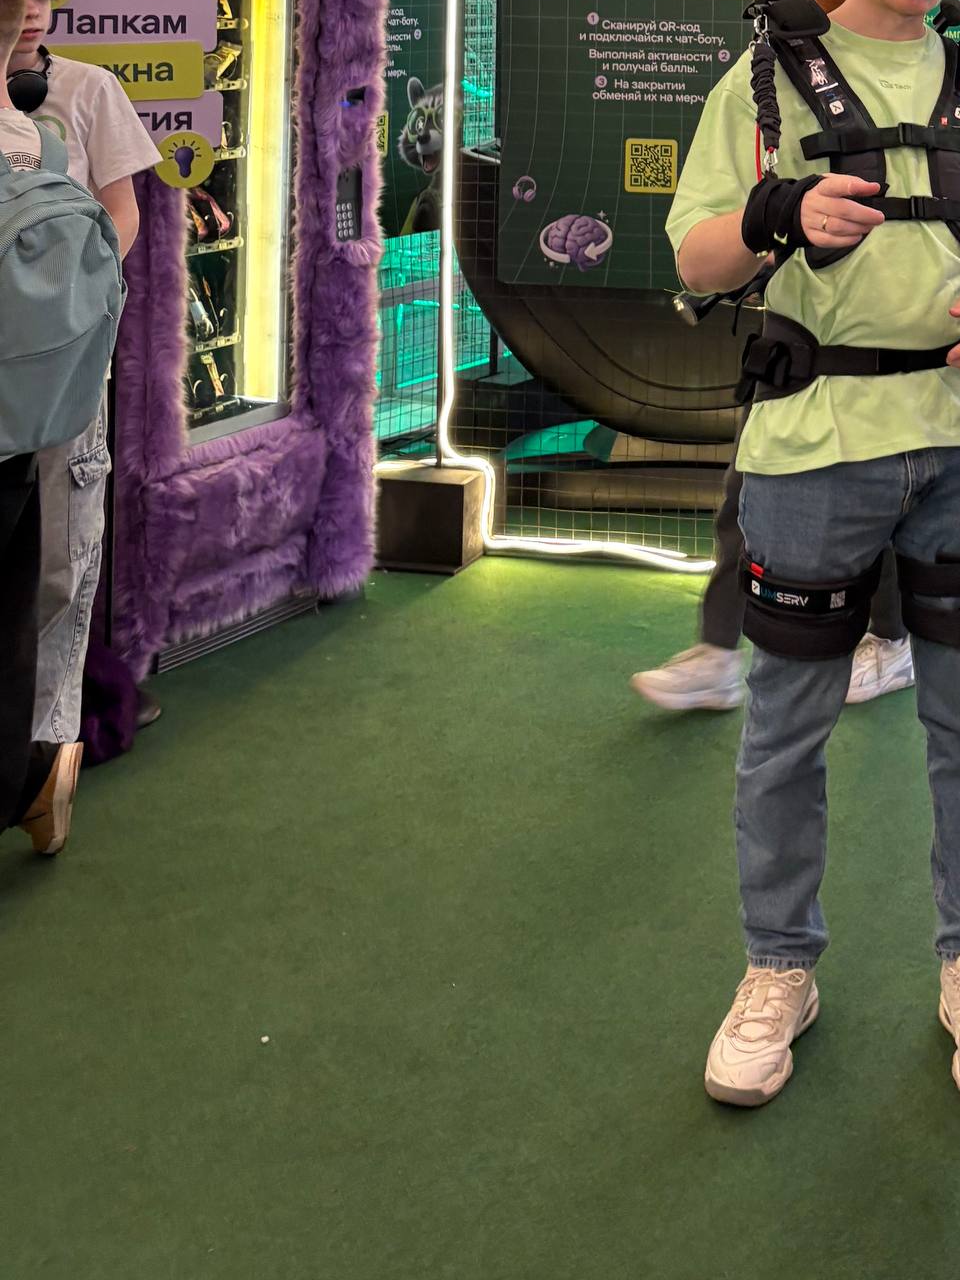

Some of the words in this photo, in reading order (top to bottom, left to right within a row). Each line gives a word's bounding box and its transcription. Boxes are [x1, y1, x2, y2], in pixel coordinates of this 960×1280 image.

[47, 8, 188, 35] Лапкам
[601, 19, 657, 33] Сканируй
[658, 21, 701, 33] QR-код
[579, 33, 587, 41] и
[589, 31, 664, 43] подключайся
[666, 35, 673, 43] к
[675, 33, 726, 46] чат-боту.
[588, 48, 646, 60] Выполняй
[647, 52, 713, 62] активности
[602, 62, 610, 71] и
[612, 61, 658, 75] получай
[660, 62, 699, 74] баллы.
[614, 79, 630, 89] На
[631, 80, 686, 92] закрытии
[592, 89, 642, 102] обменяй
[643, 93, 658, 102] их
[659, 94, 674, 103] на
[675, 94, 708, 105] мерч.
